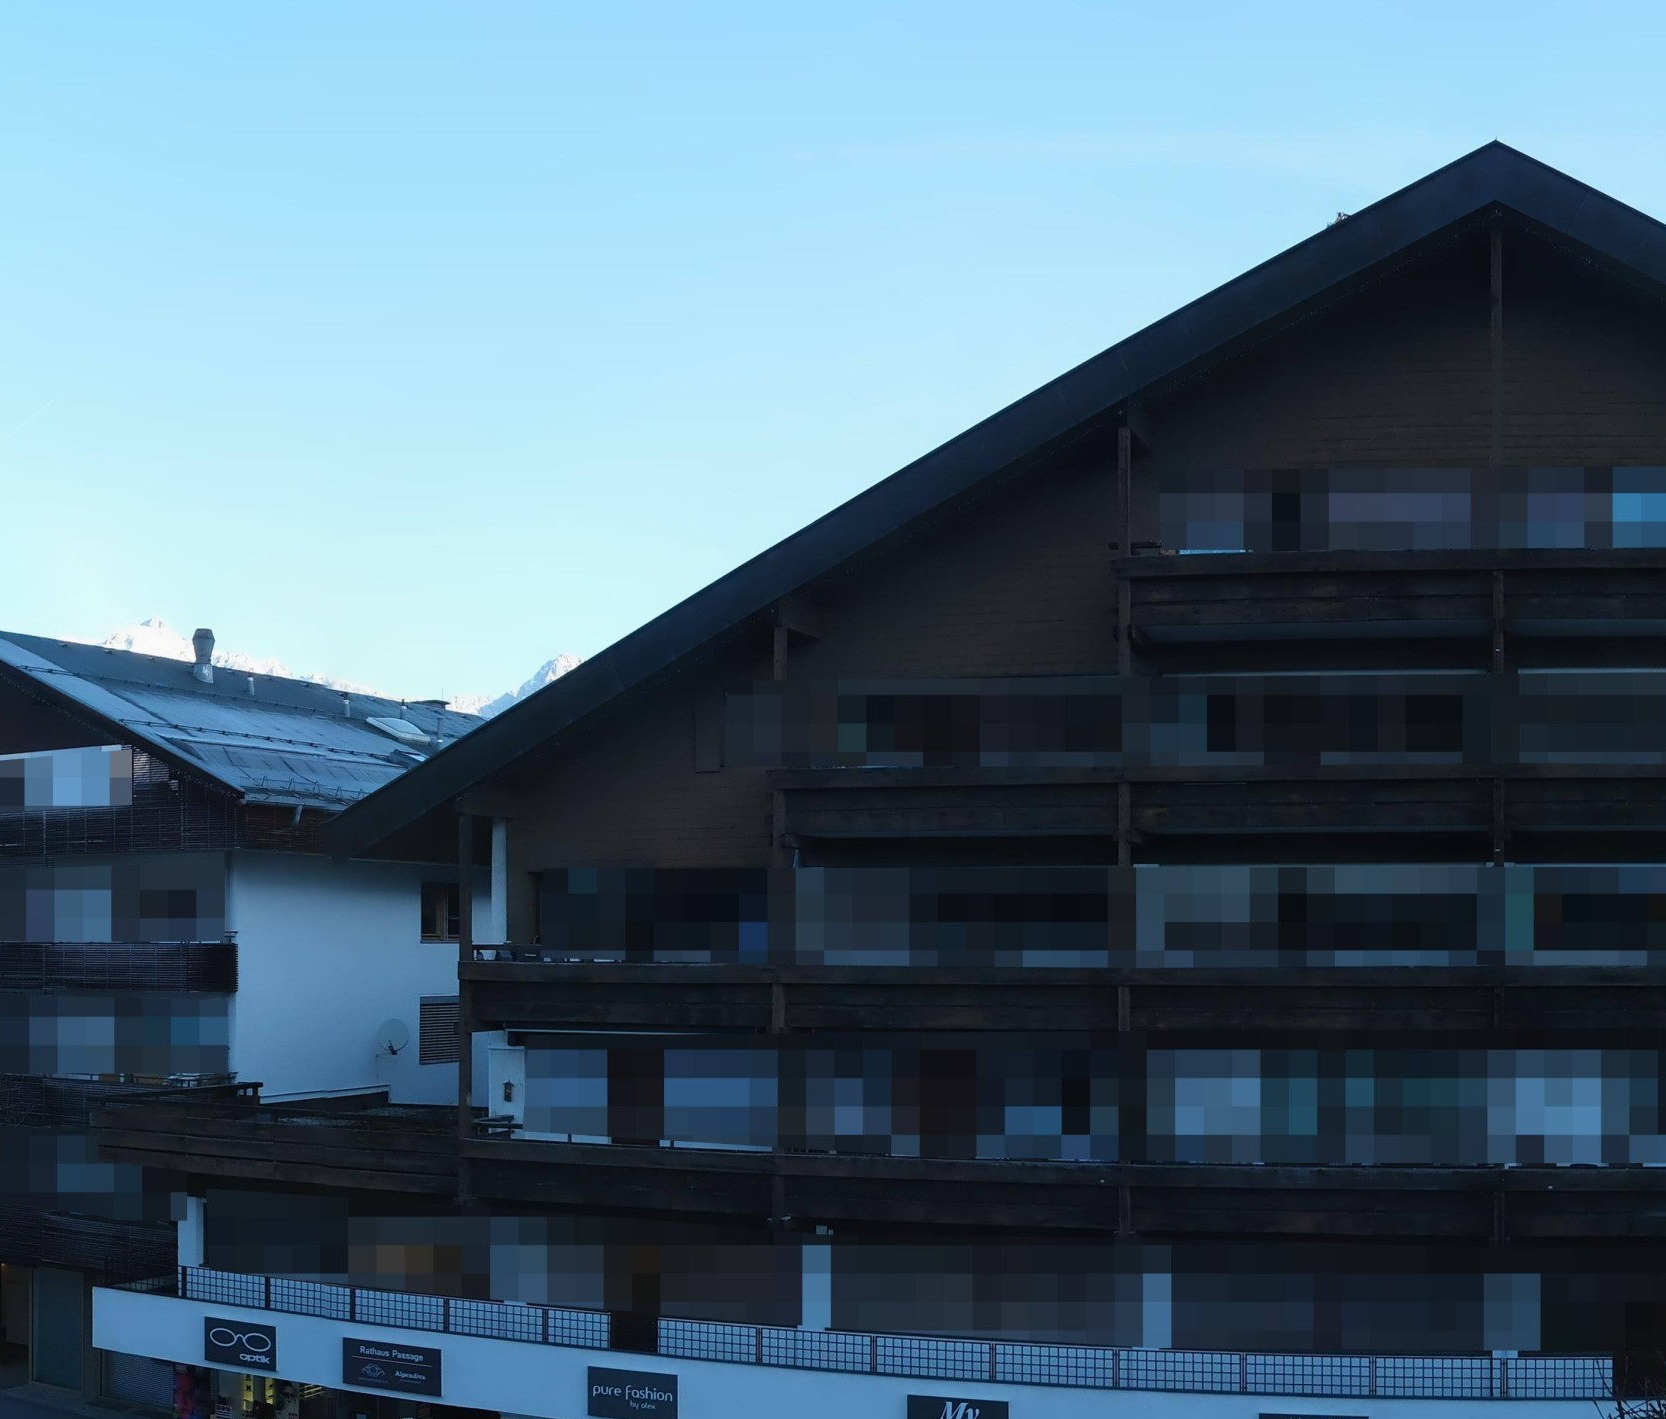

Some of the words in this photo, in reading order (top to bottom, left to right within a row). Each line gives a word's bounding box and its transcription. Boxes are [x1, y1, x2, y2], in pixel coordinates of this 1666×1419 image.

[359, 1345, 390, 1357] Rathaus
[392, 1349, 424, 1362] Passage
[592, 1385, 622, 1397] pure
[625, 1385, 673, 1402] fashion
